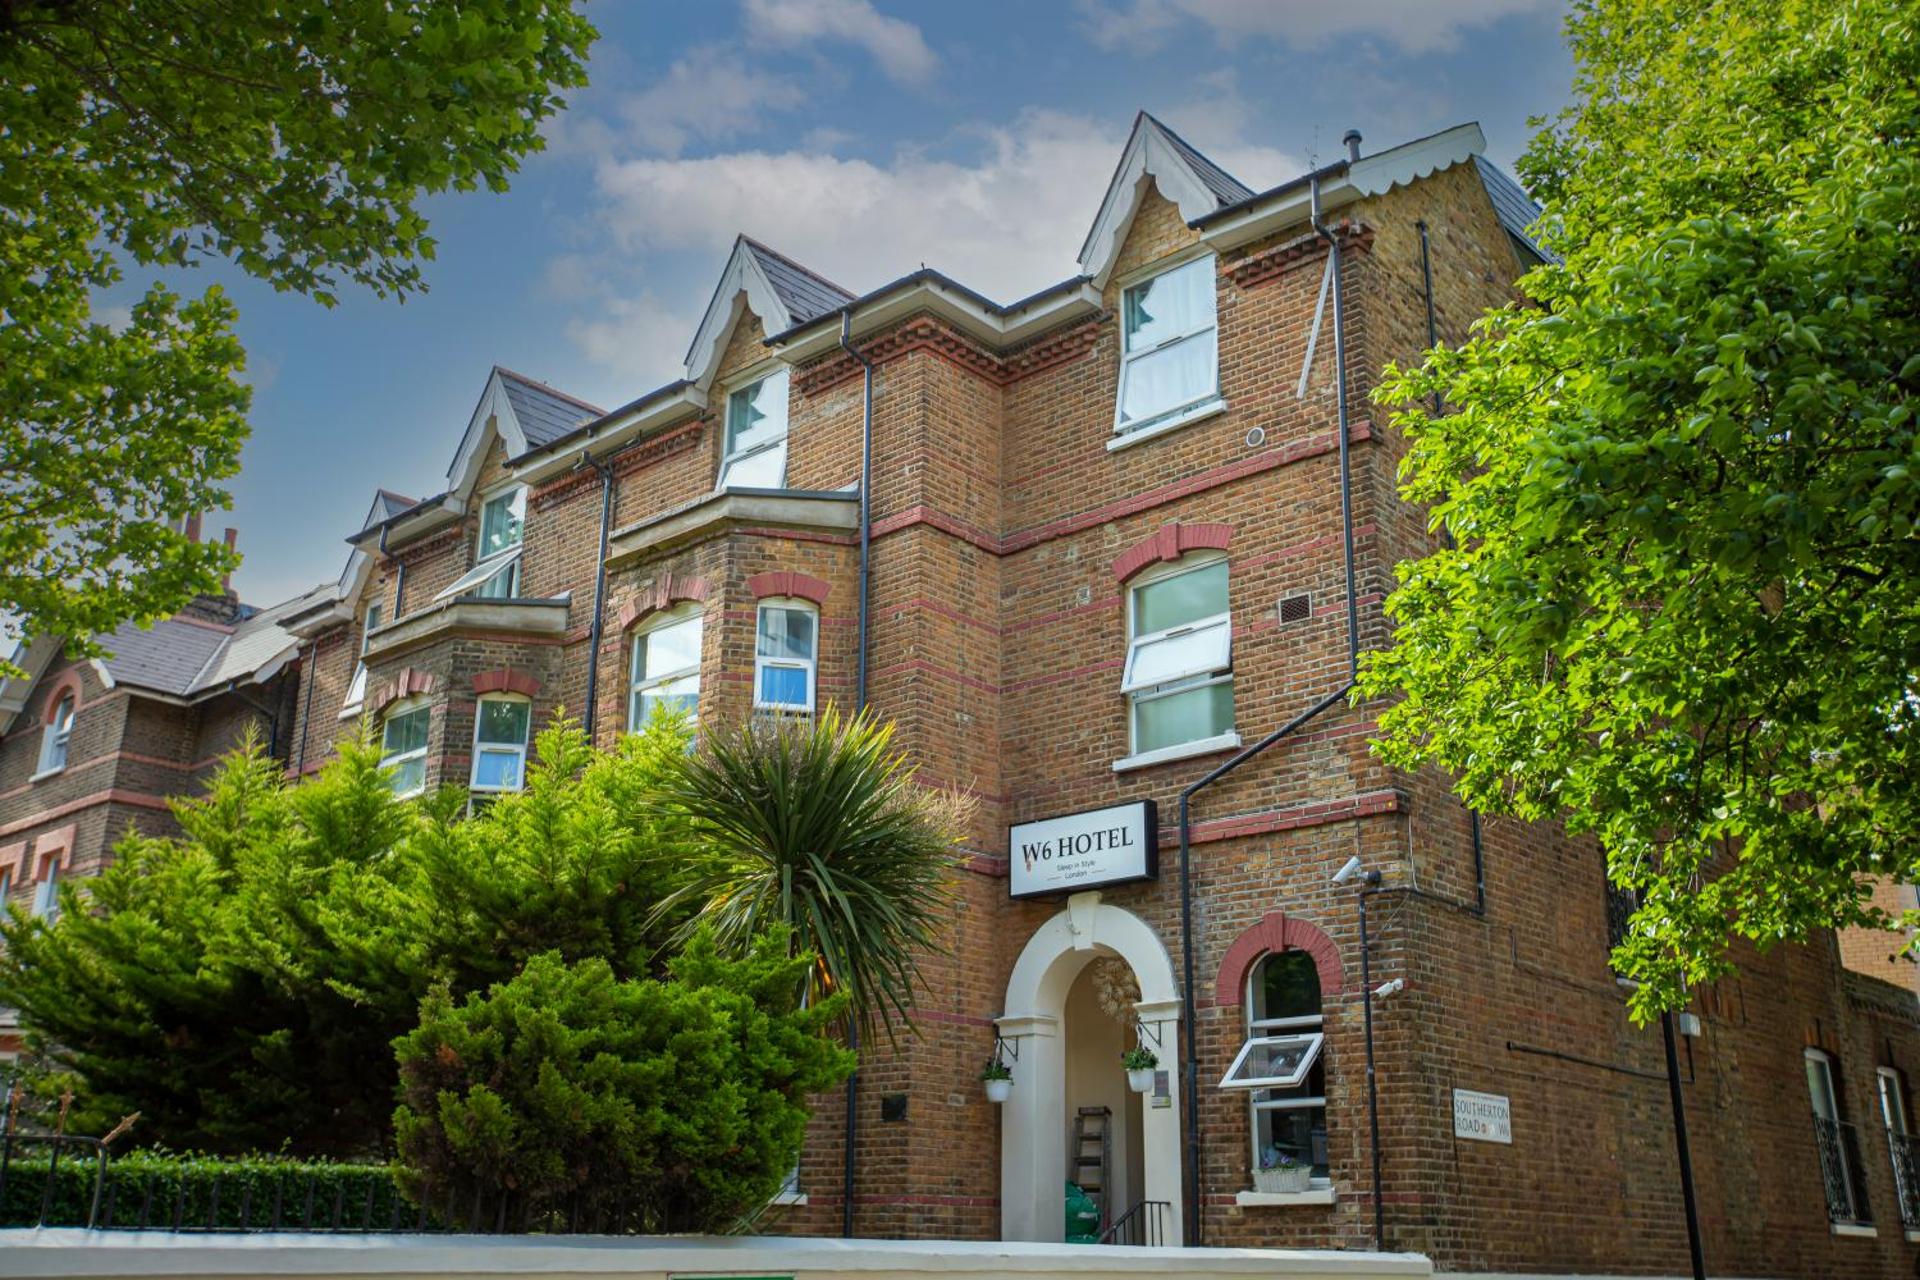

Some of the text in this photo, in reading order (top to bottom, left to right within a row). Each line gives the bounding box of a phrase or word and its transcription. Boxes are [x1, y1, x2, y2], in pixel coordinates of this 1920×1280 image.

[1022, 826, 1134, 864] W6 HOTEL
[1065, 871, 1088, 879] London
[1455, 1100, 1509, 1120] SOUTHERTON
[1457, 1117, 1480, 1133] ROAD
